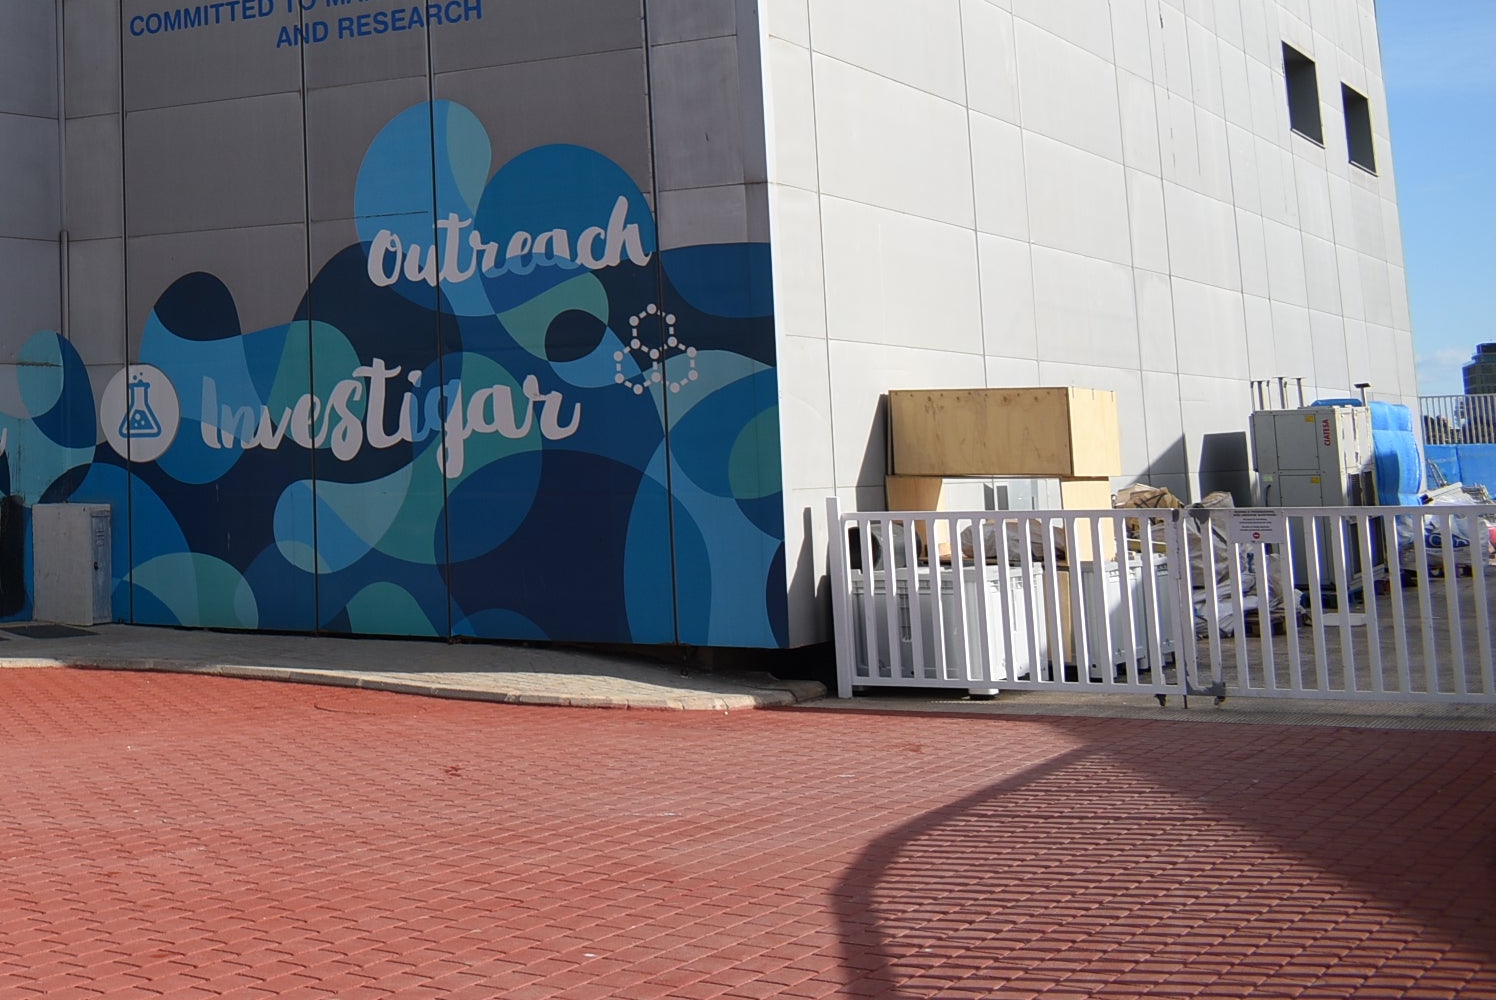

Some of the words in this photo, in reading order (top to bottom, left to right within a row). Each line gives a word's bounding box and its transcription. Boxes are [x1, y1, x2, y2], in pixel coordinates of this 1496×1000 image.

[276, 19, 329, 49] AND
[366, 195, 653, 287] Outreach
[200, 357, 582, 479] Investigar
[1321, 418, 1332, 447] CIATESA
